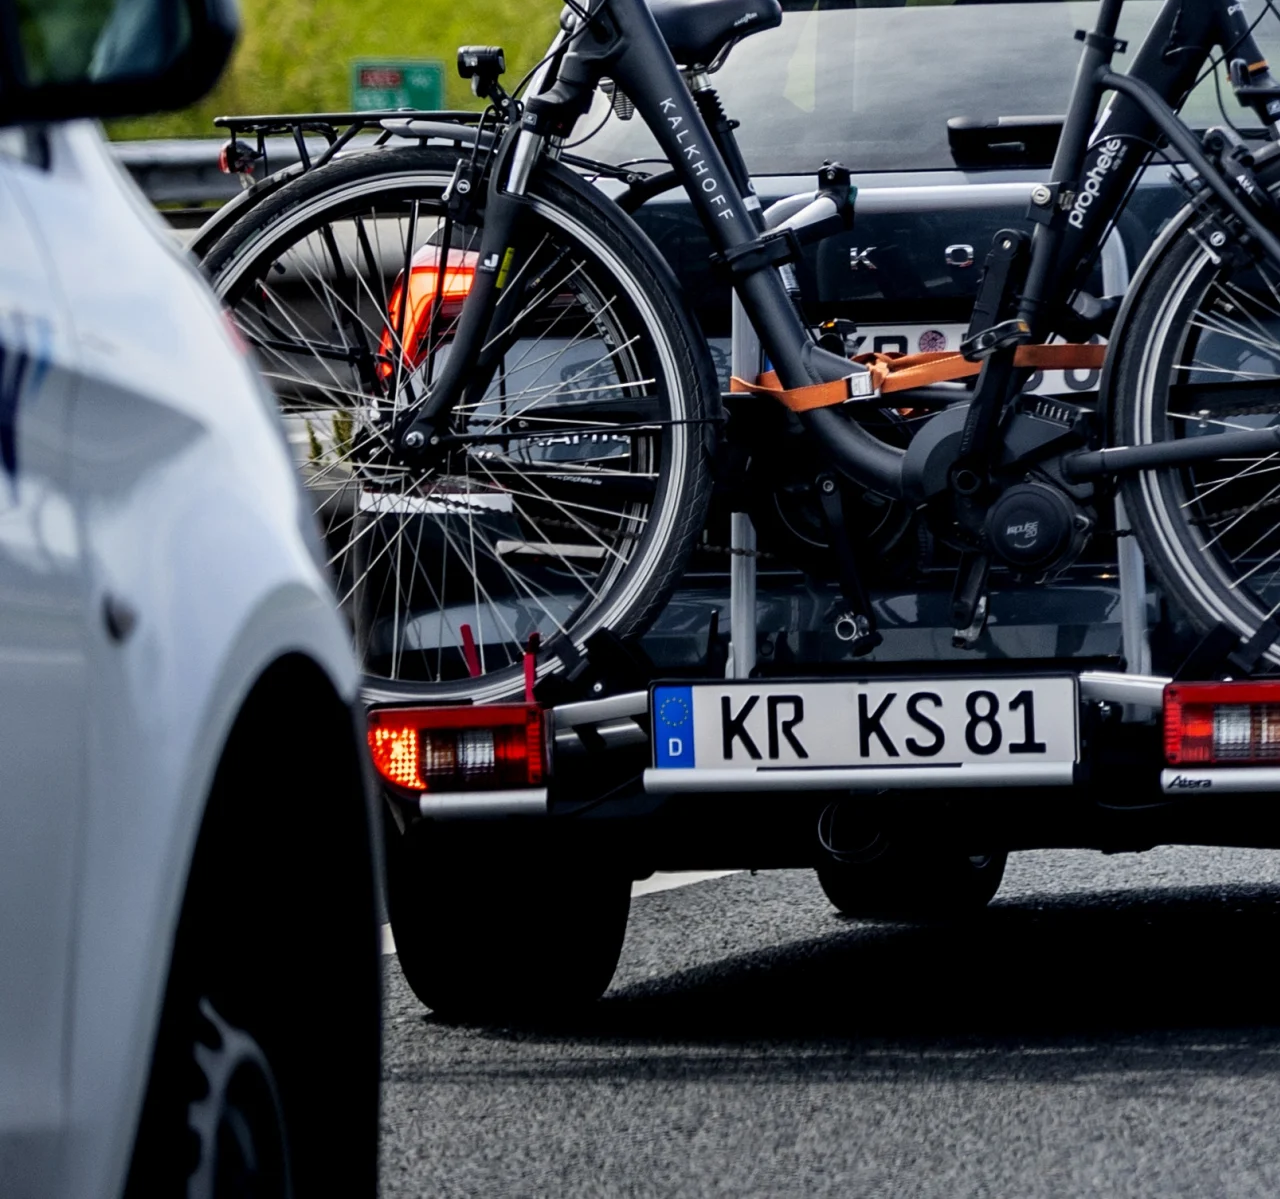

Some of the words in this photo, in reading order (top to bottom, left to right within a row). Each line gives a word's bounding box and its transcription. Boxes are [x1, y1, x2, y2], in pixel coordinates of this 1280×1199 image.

[659, 97, 734, 220] KALKHOFF
[1068, 138, 1122, 229] prophete
[667, 737, 683, 757] D
[721, 694, 809, 760] KR
